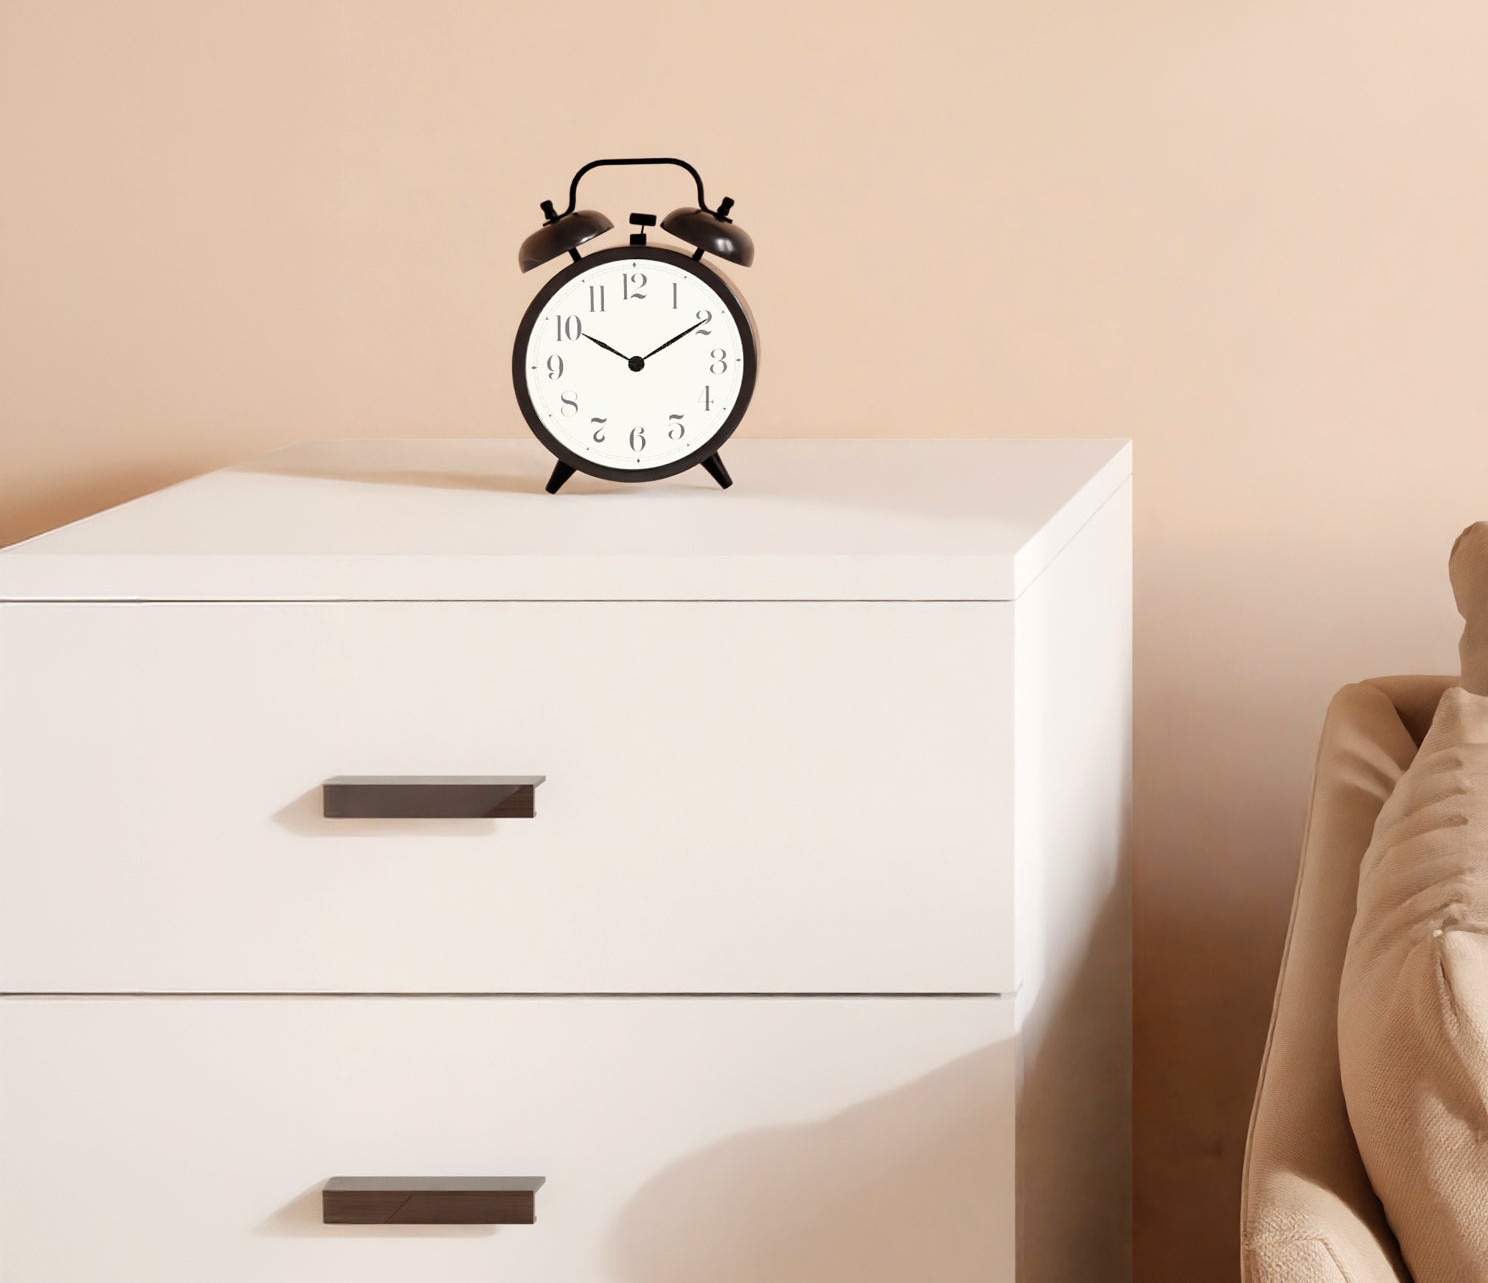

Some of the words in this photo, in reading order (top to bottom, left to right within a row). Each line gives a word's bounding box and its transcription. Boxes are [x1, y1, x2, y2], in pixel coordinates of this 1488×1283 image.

[590, 286, 605, 312] 11
[623, 273, 647, 300] 12
[671, 282, 679, 310] 1
[557, 315, 582, 341] 10
[695, 310, 712, 335] 2
[547, 355, 563, 379] 9
[710, 349, 727, 374] 3
[561, 392, 578, 416] 8
[698, 385, 714, 411] 4
[629, 427, 646, 451] 6
[668, 414, 685, 439] 5
